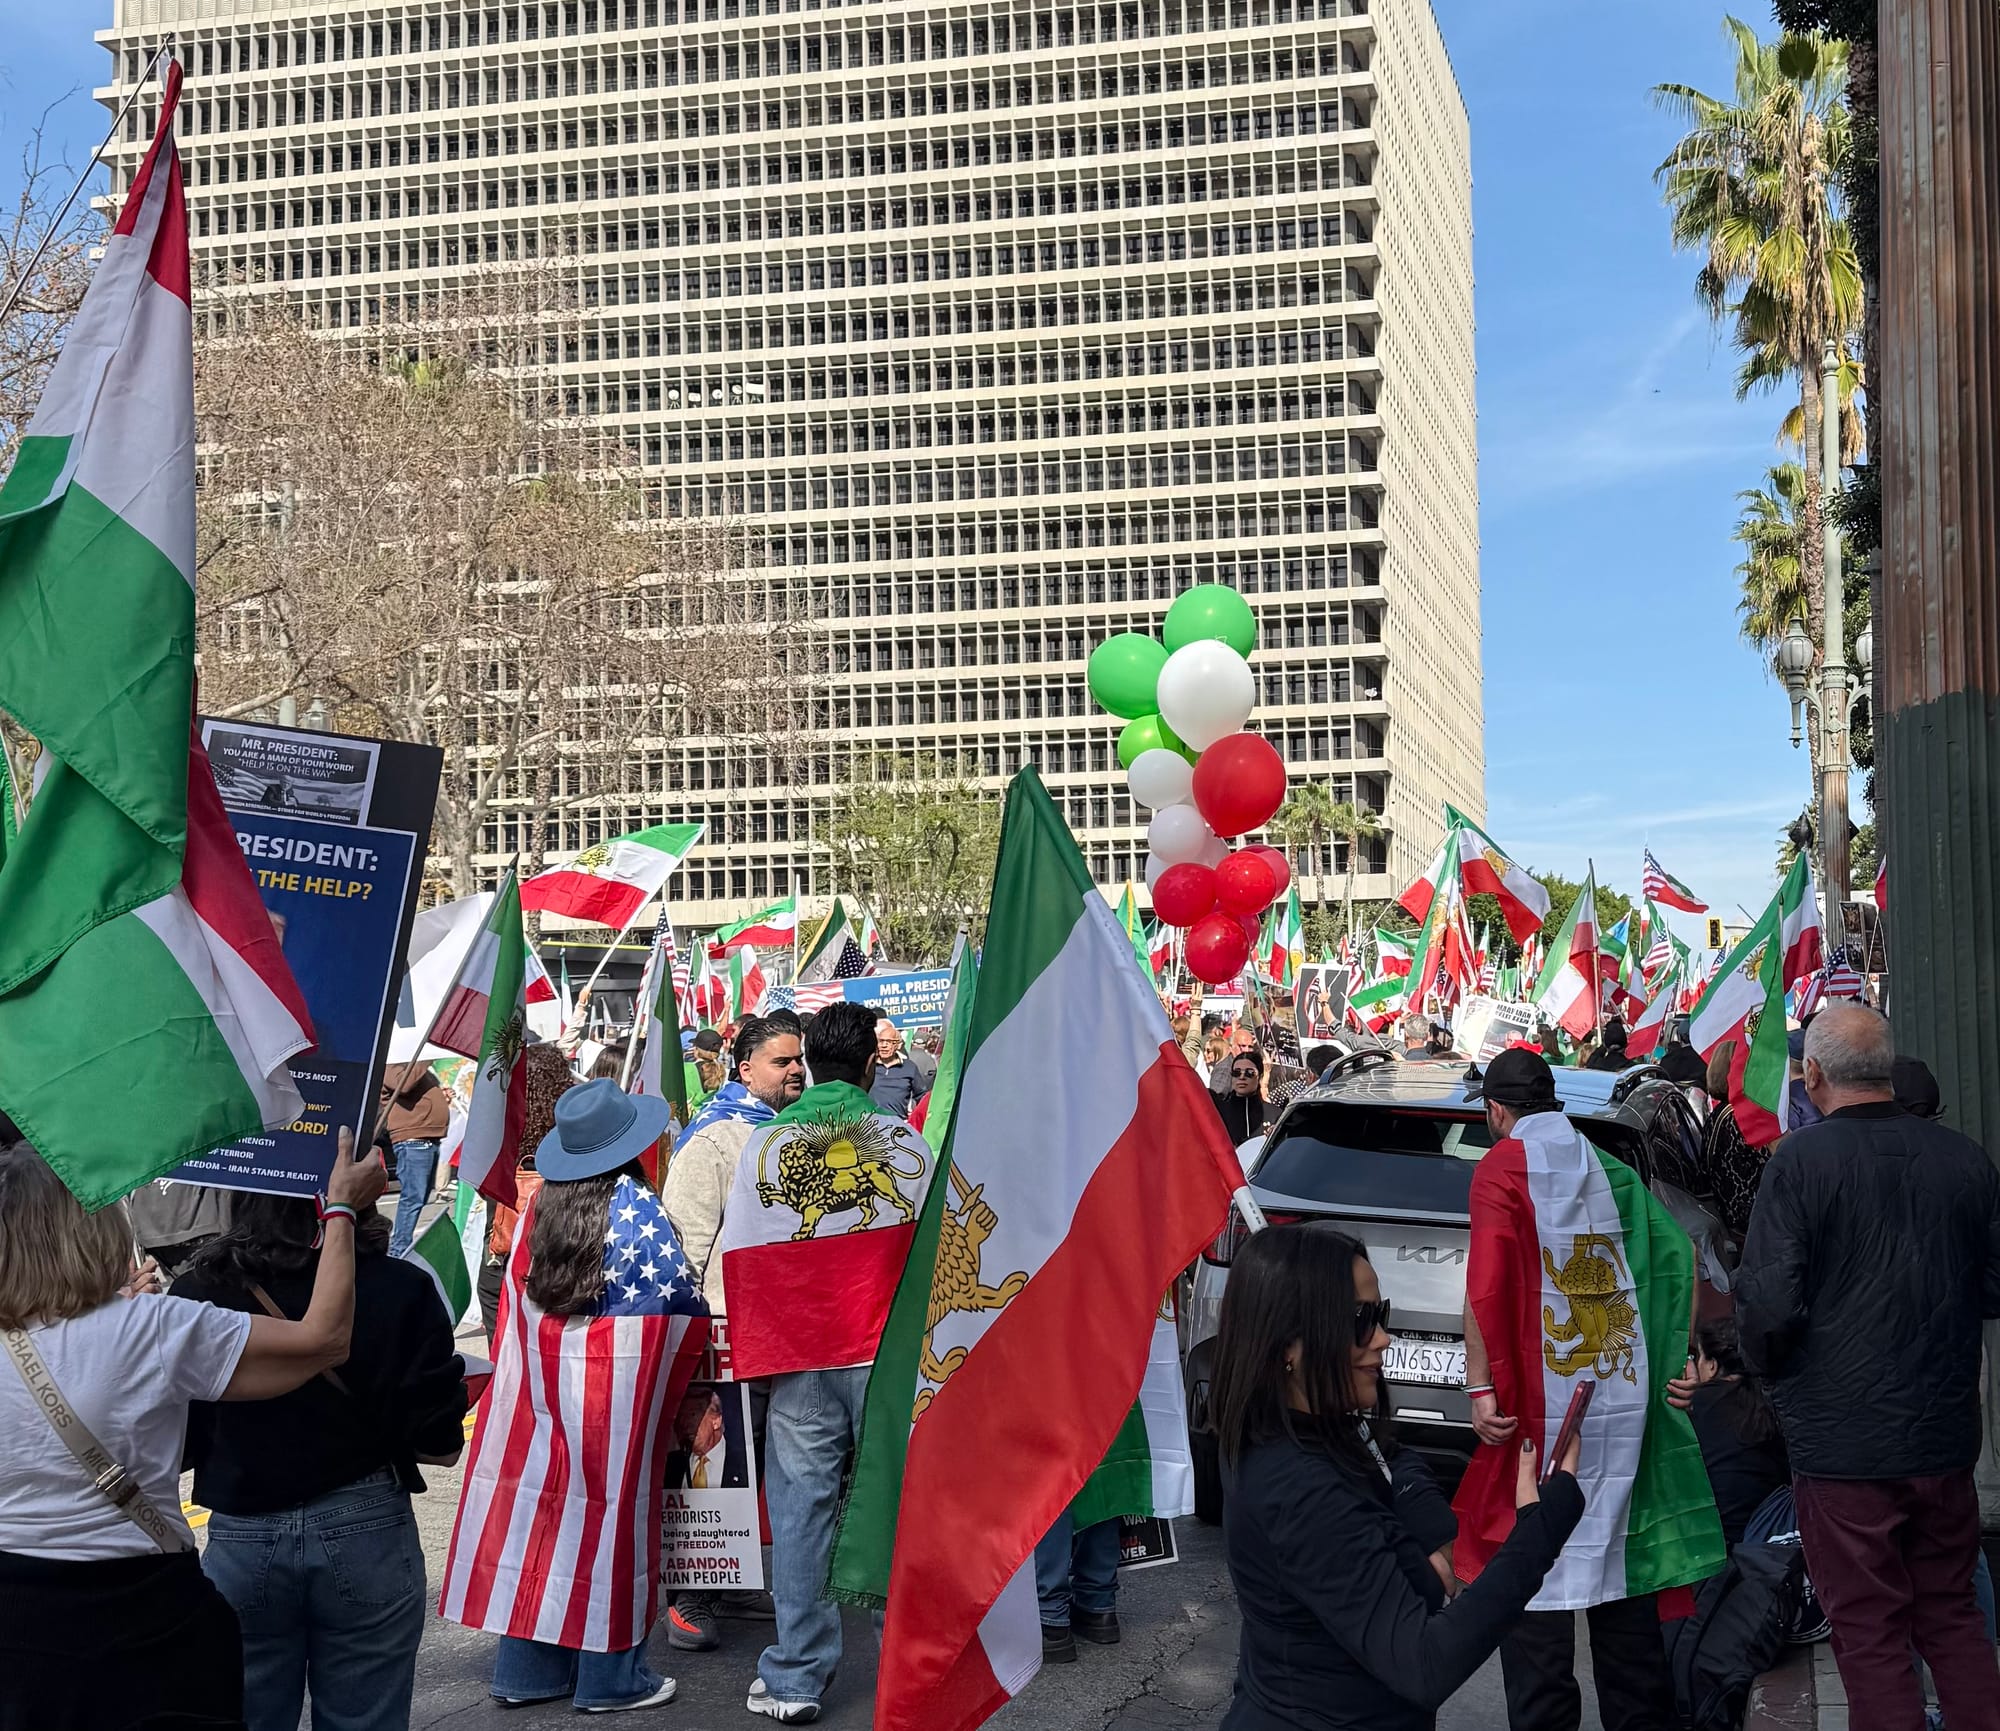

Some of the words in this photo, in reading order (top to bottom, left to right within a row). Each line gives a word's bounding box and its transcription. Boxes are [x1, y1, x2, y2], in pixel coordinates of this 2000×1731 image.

[241, 737, 264, 751] MR.
[267, 741, 339, 761] PRESIDENT:
[223, 747, 240, 757] YOU
[240, 750, 259, 760] ARE
[267, 754, 287, 763] MAN
[288, 757, 300, 765] OF
[302, 759, 325, 769] YOUR
[324, 761, 354, 773] WORD!
[276, 763, 291, 773] ON
[292, 766, 311, 776] THE
[236, 832, 379, 872] RESIDENT:
[257, 869, 299, 891] THE
[304, 875, 373, 900] HELP?
[880, 983, 904, 996] MR.
[905, 978, 951, 993] PRESID
[863, 998, 882, 1009] YOU
[883, 996, 900, 1006] ARE
[901, 995, 908, 1004] A
[909, 993, 930, 1003] MAN
[931, 992, 942, 1001] OF
[910, 1003, 919, 1013] IS
[921, 1001, 936, 1013] ON
[312, 1073, 337, 1083] MOST
[236, 1136, 276, 1148] RENGTH
[183, 1159, 220, 1170] REEDOM
[228, 1164, 250, 1174] IRAN
[251, 1167, 285, 1178] STANDS
[286, 1171, 319, 1182] READY!
[1384, 1346, 1467, 1374] DN65S73
[7, 1328, 44, 1385] CHAEL
[36, 1382, 73, 1429] KORS
[1425, 1373, 1446, 1384] THE
[665, 1494, 690, 1509] AL
[134, 1499, 167, 1537] KORS
[661, 1510, 722, 1524] ERRORISTS
[663, 1528, 690, 1539] being
[692, 1528, 750, 1539] slaughtered
[676, 1540, 726, 1550] FREEDOM
[1121, 1545, 1147, 1560] VER
[666, 1557, 740, 1570] ABANDON
[658, 1571, 690, 1585] NIAN
[693, 1571, 742, 1585] PEOPLE
